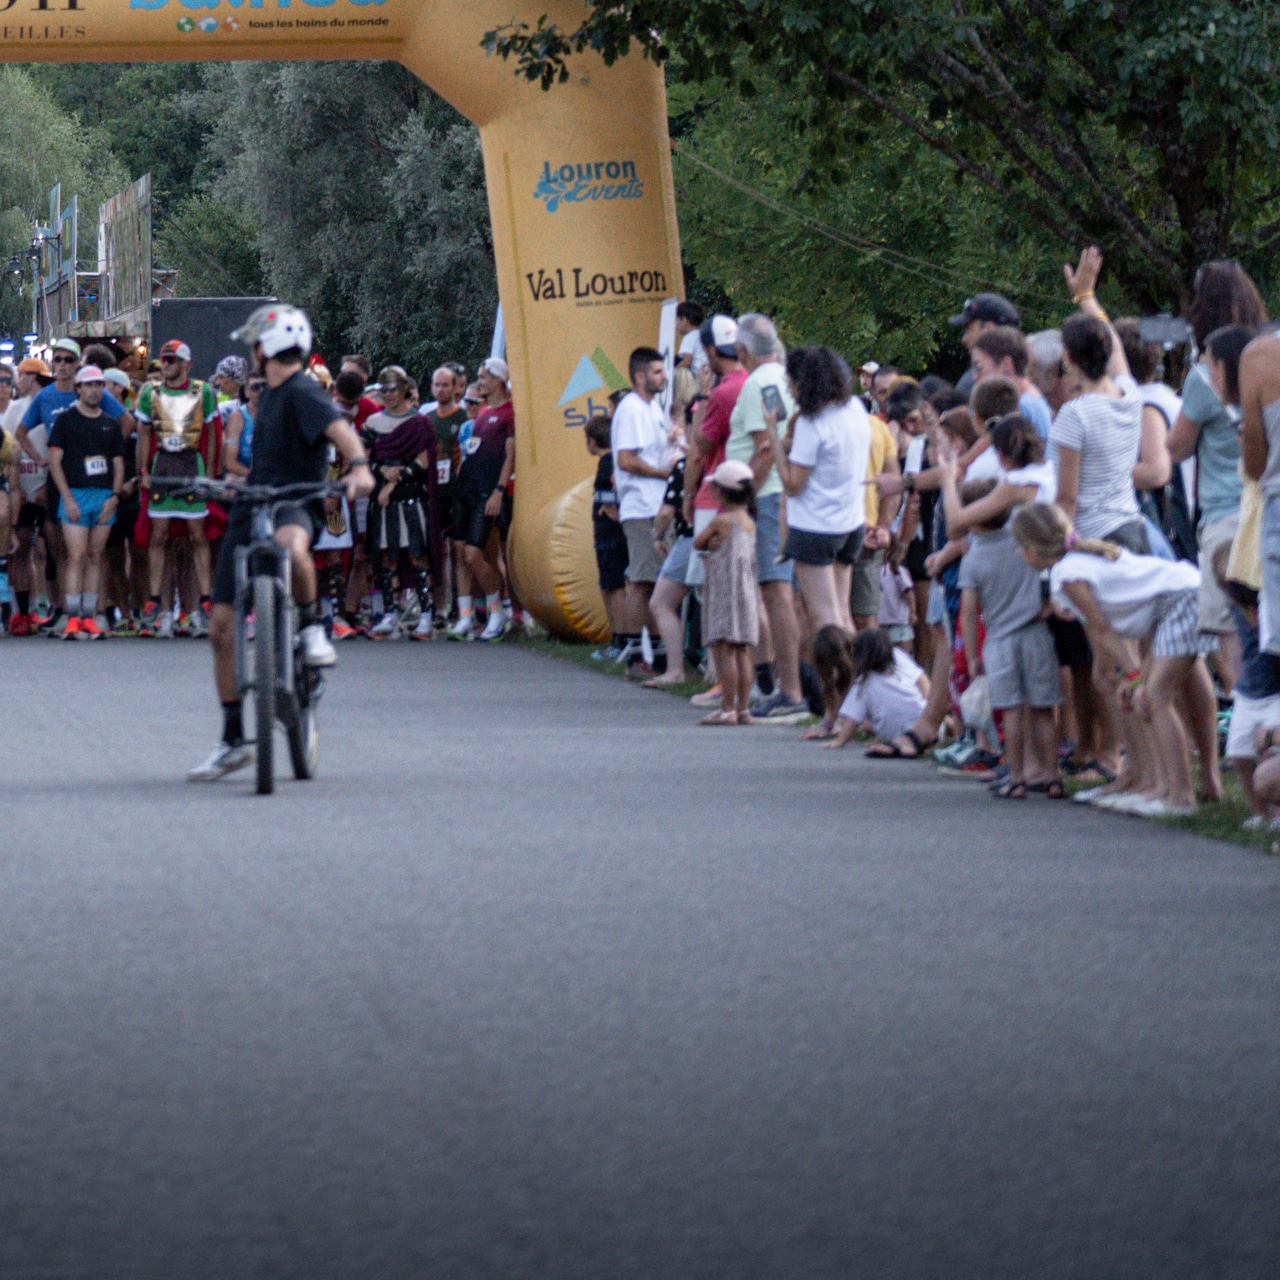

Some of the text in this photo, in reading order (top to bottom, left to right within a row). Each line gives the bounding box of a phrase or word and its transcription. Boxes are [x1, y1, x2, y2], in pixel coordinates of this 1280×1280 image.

[248, 16, 391, 29] tous les bains du monde
[543, 159, 637, 184] Louron
[571, 177, 645, 203] Events
[526, 268, 667, 302] Val Louron
